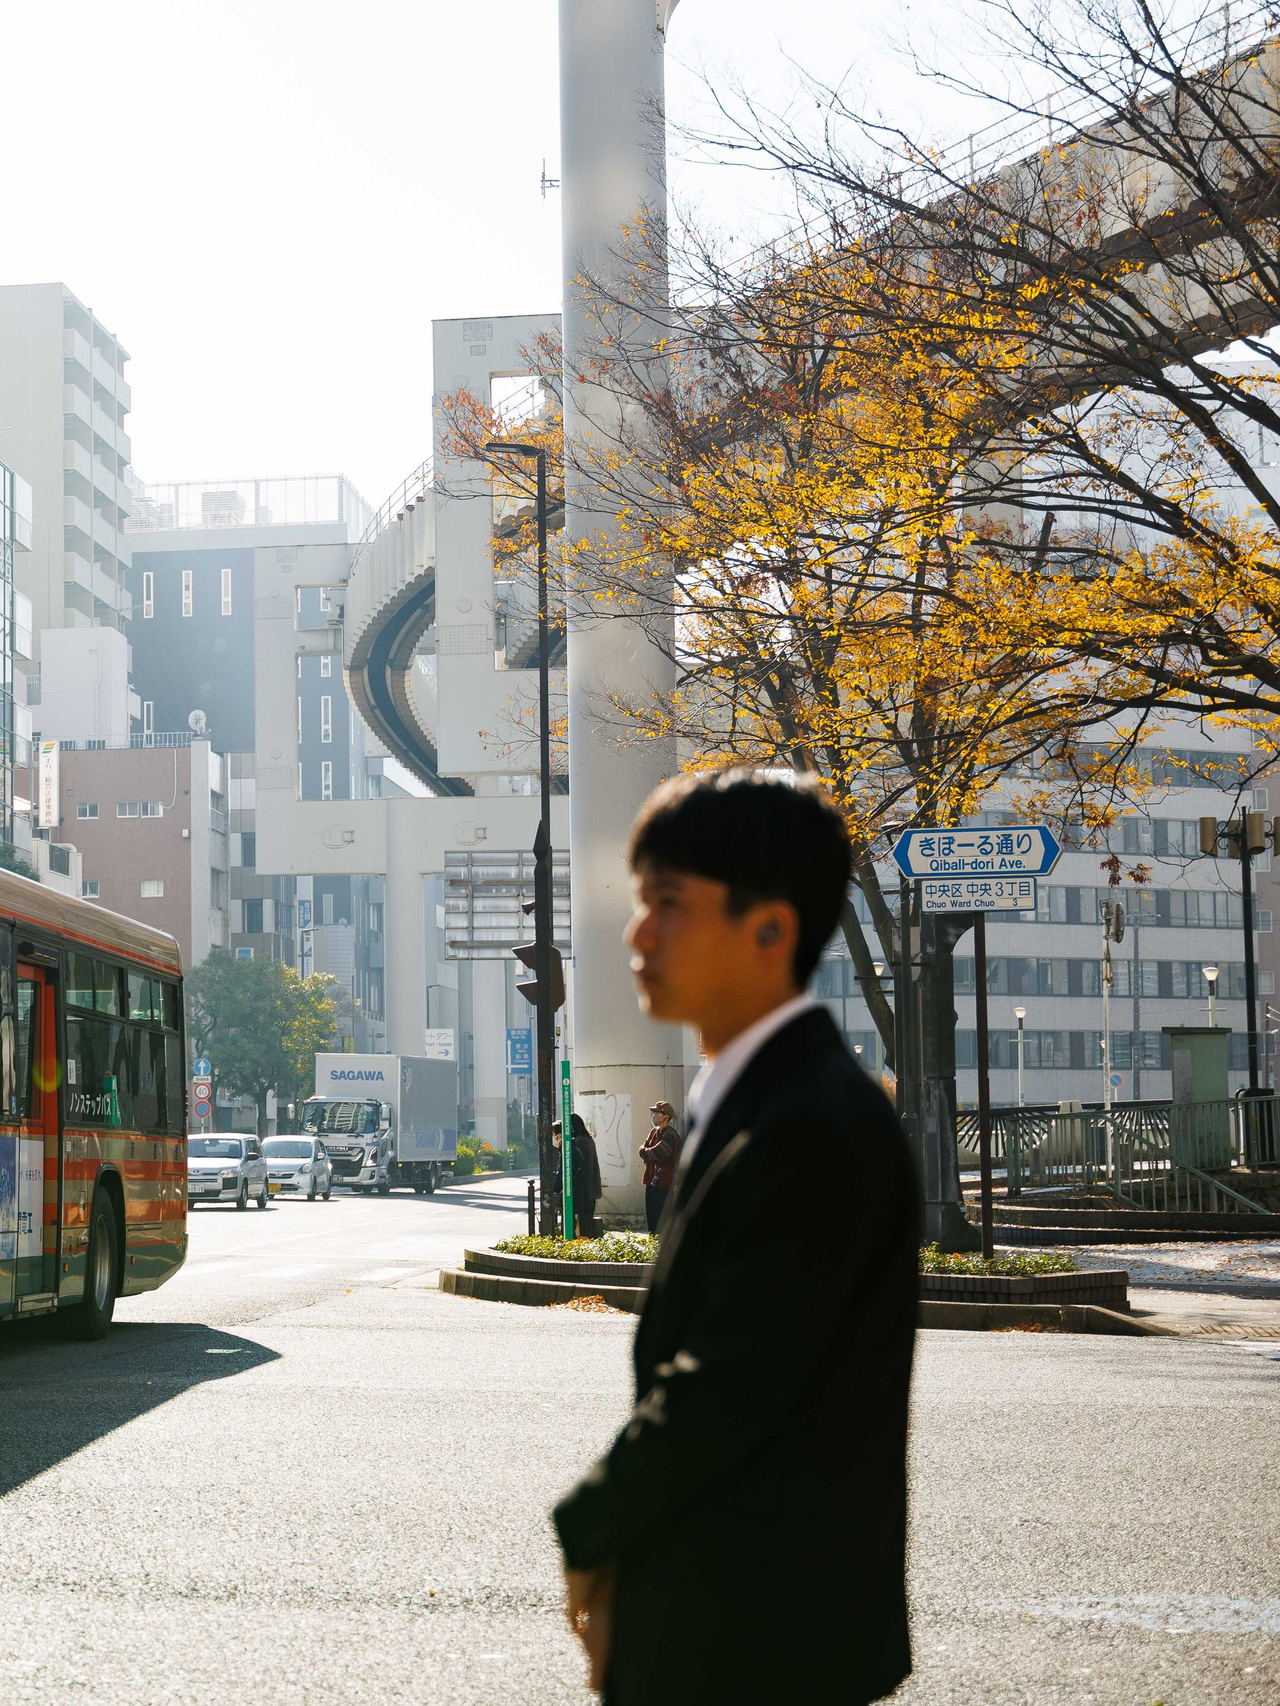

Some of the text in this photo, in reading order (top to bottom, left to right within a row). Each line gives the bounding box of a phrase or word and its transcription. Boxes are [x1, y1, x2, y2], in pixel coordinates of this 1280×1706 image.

[918, 833, 1033, 858] きぼーる通り
[929, 857, 1026, 872] Qiball-dori Ave.
[925, 881, 1031, 899] 中央区 中央3丁目
[926, 897, 1018, 909] Chuo Ward Chuo 3
[330, 1070, 385, 1081] SAGAWA
[197, 1087, 207, 1097] 40
[69, 1092, 112, 1116] ノンステップバス
